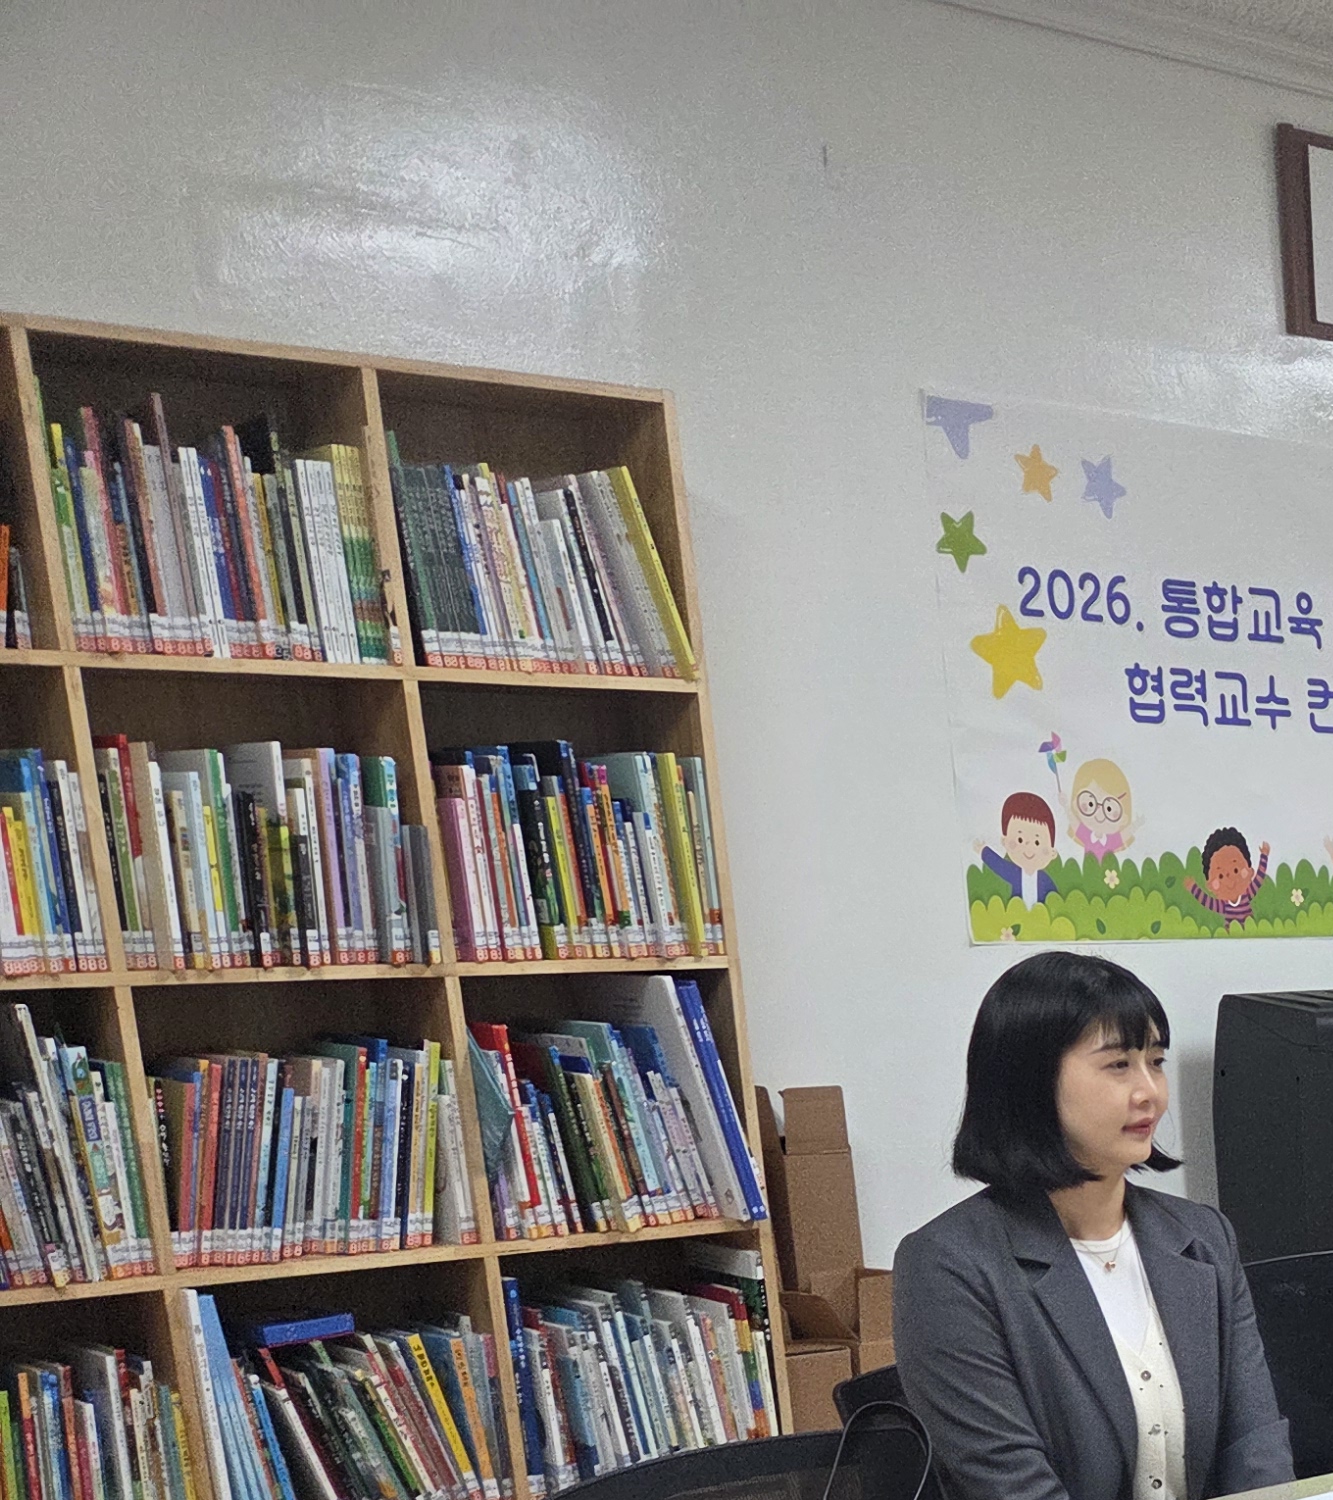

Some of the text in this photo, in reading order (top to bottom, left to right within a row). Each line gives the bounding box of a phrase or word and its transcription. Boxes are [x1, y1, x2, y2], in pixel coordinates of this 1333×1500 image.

[1017, 565, 1145, 633] 2026.
[1161, 578, 1323, 649] 통합교육
[1125, 662, 1292, 731] 협력교수
